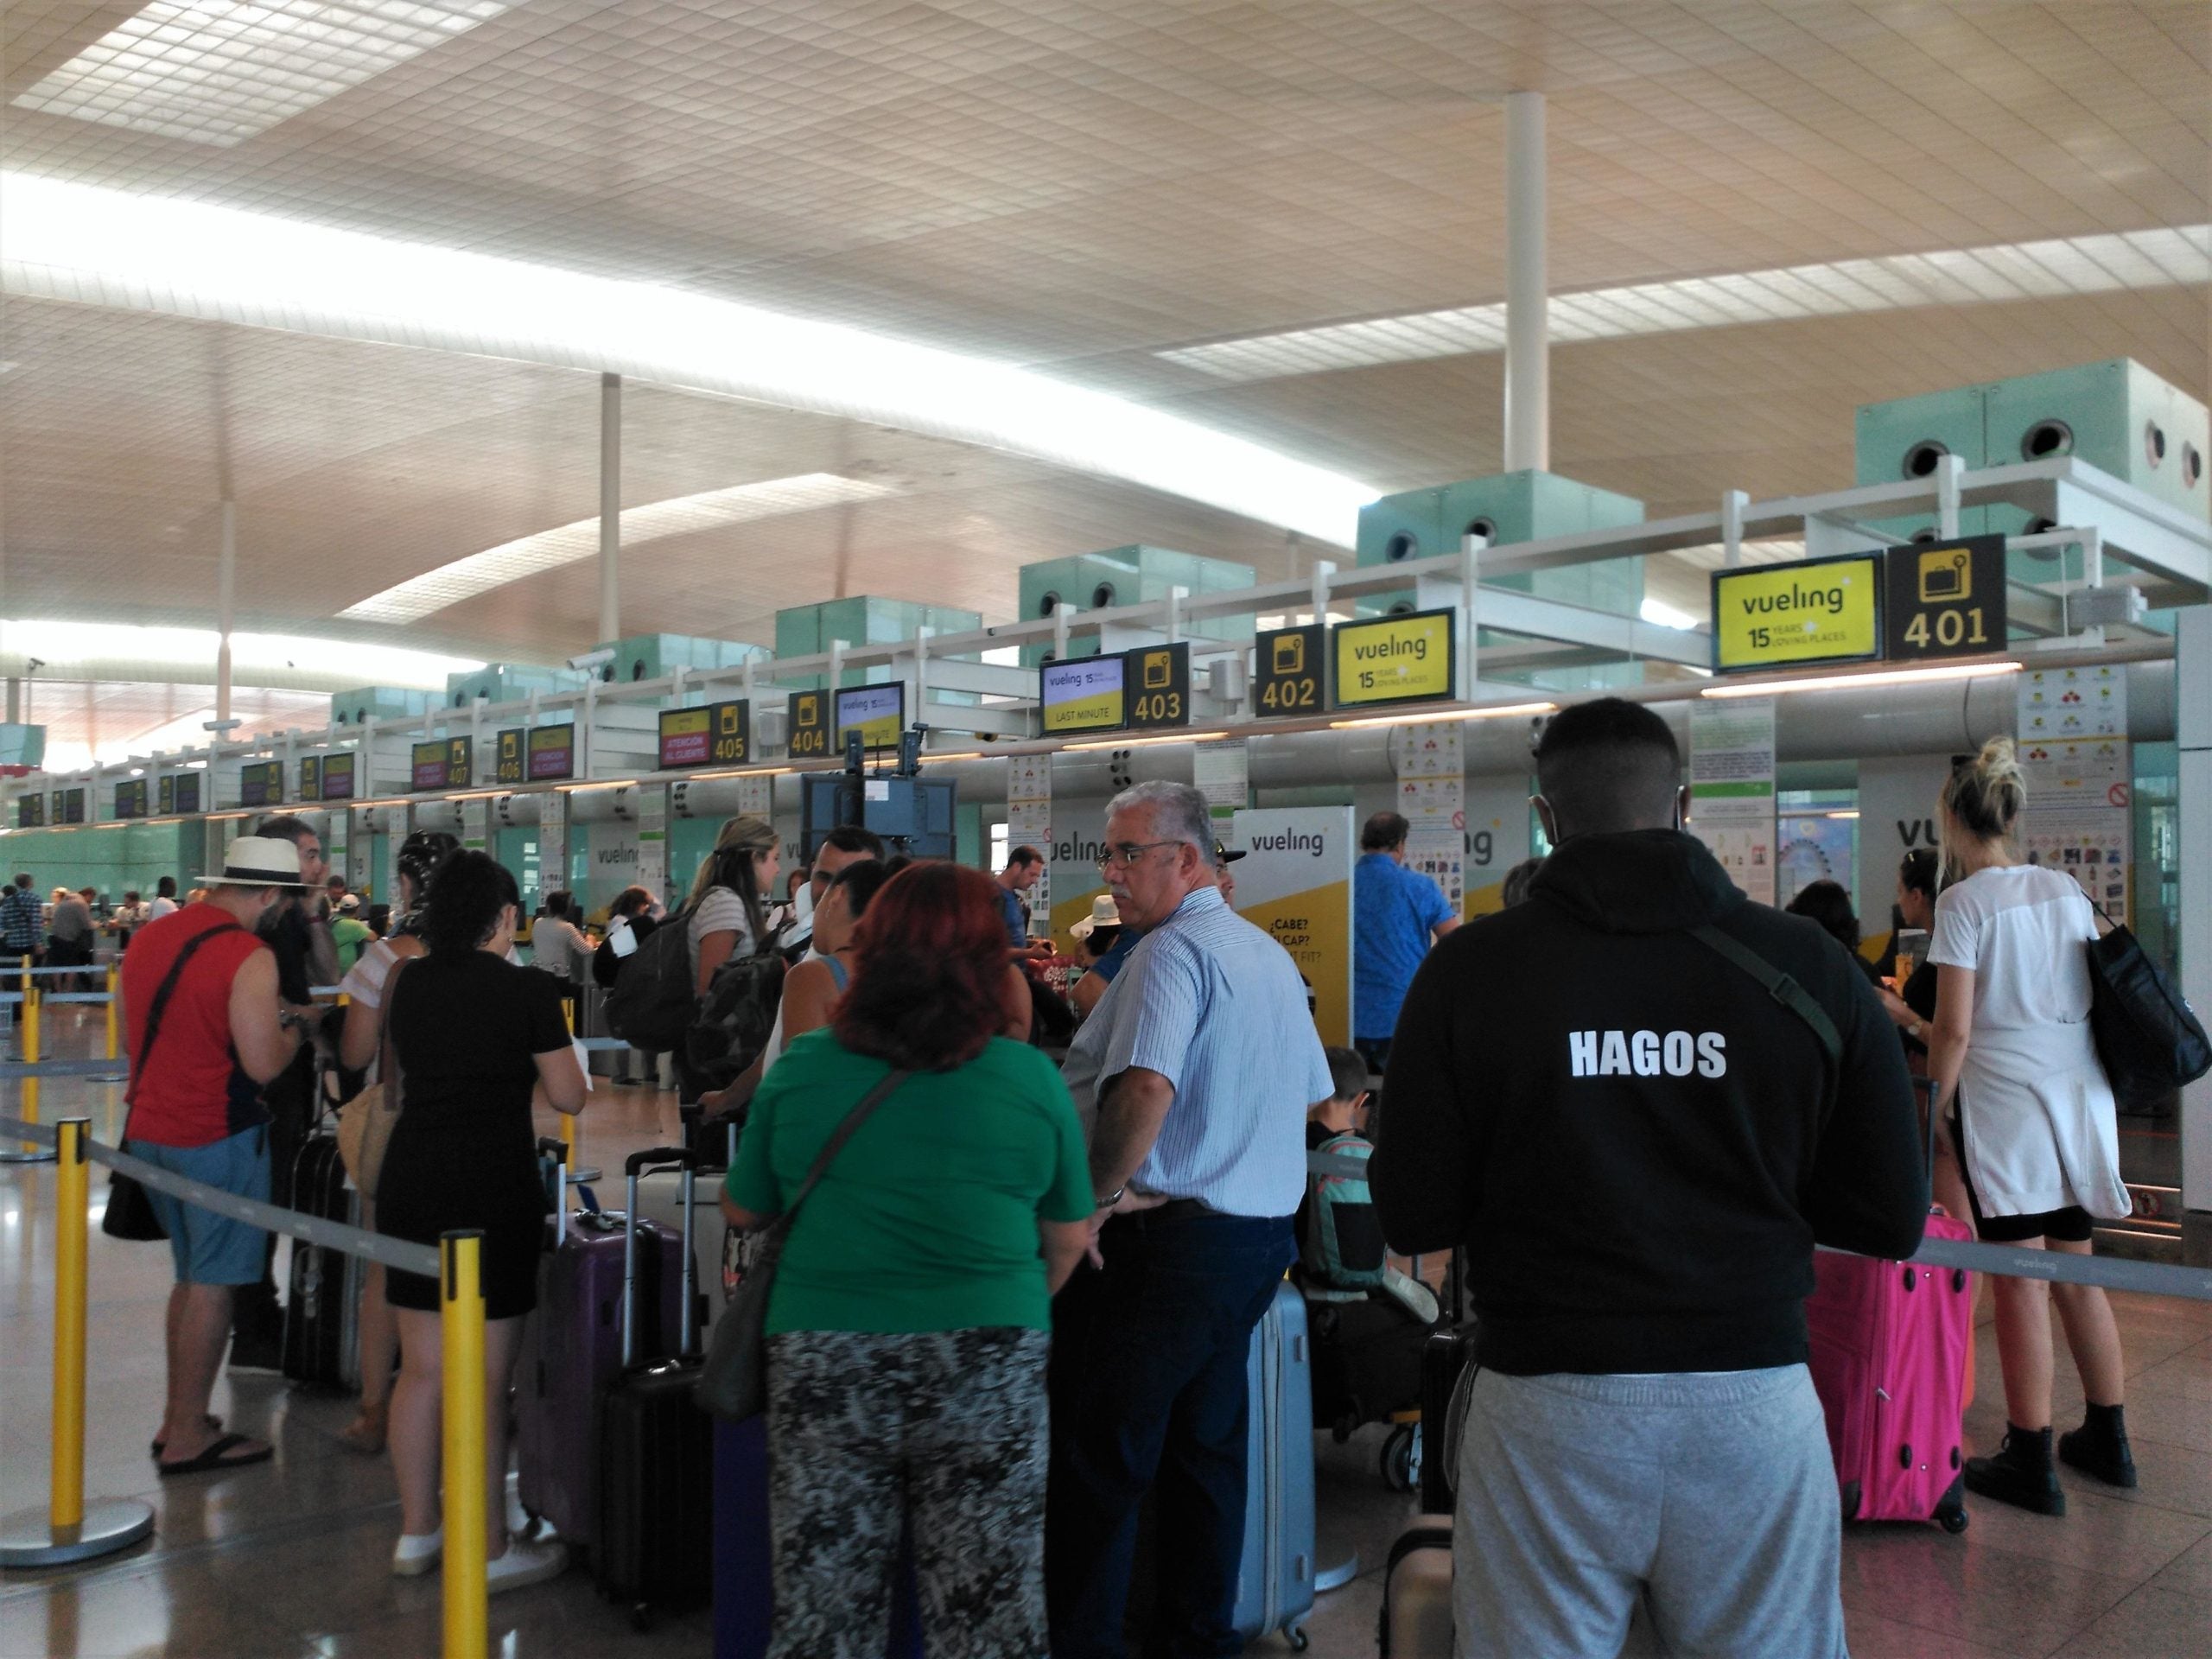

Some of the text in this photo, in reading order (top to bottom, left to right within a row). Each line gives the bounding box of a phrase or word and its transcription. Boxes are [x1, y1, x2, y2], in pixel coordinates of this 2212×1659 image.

[1743, 583, 1843, 614] vueling
[1748, 627, 1770, 648] 15
[1904, 607, 1988, 648] 401
[1355, 634, 1427, 660] vueling
[1050, 672, 1081, 687] vueling
[1085, 673, 1093, 683] 15
[1358, 671, 1374, 689] 15
[1262, 677, 1315, 708] 402
[1056, 707, 1109, 722] LAST MINUTE
[1135, 692, 1180, 721] 403
[715, 738, 744, 759] 405
[792, 729, 824, 752] 404
[1252, 827, 1324, 857] vueling
[1269, 918, 1308, 933] ¿CABE?
[1282, 935, 1310, 946] CAP?
[1300, 951, 1321, 963] FIT?
[1569, 1029, 1727, 1078] HAGOS
